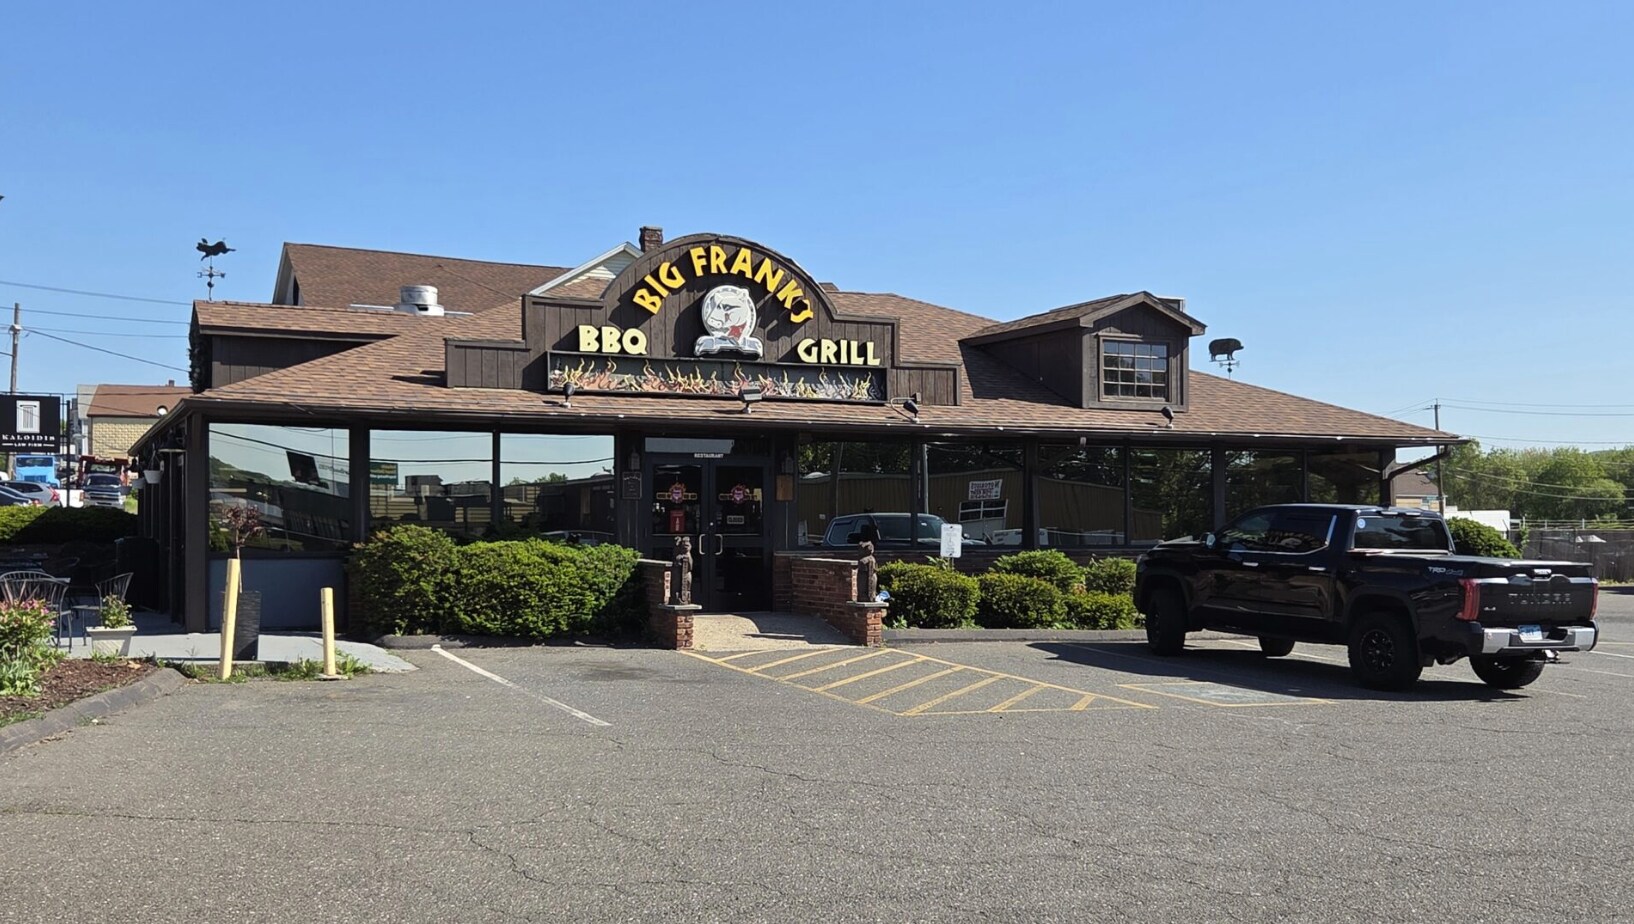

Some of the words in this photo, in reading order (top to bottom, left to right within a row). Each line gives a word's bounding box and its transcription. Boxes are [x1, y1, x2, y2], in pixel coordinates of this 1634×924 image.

[633, 262, 686, 315] BIG
[689, 245, 814, 323] FRANK'S
[578, 325, 648, 356] BBQ
[797, 338, 881, 366] GRILL
